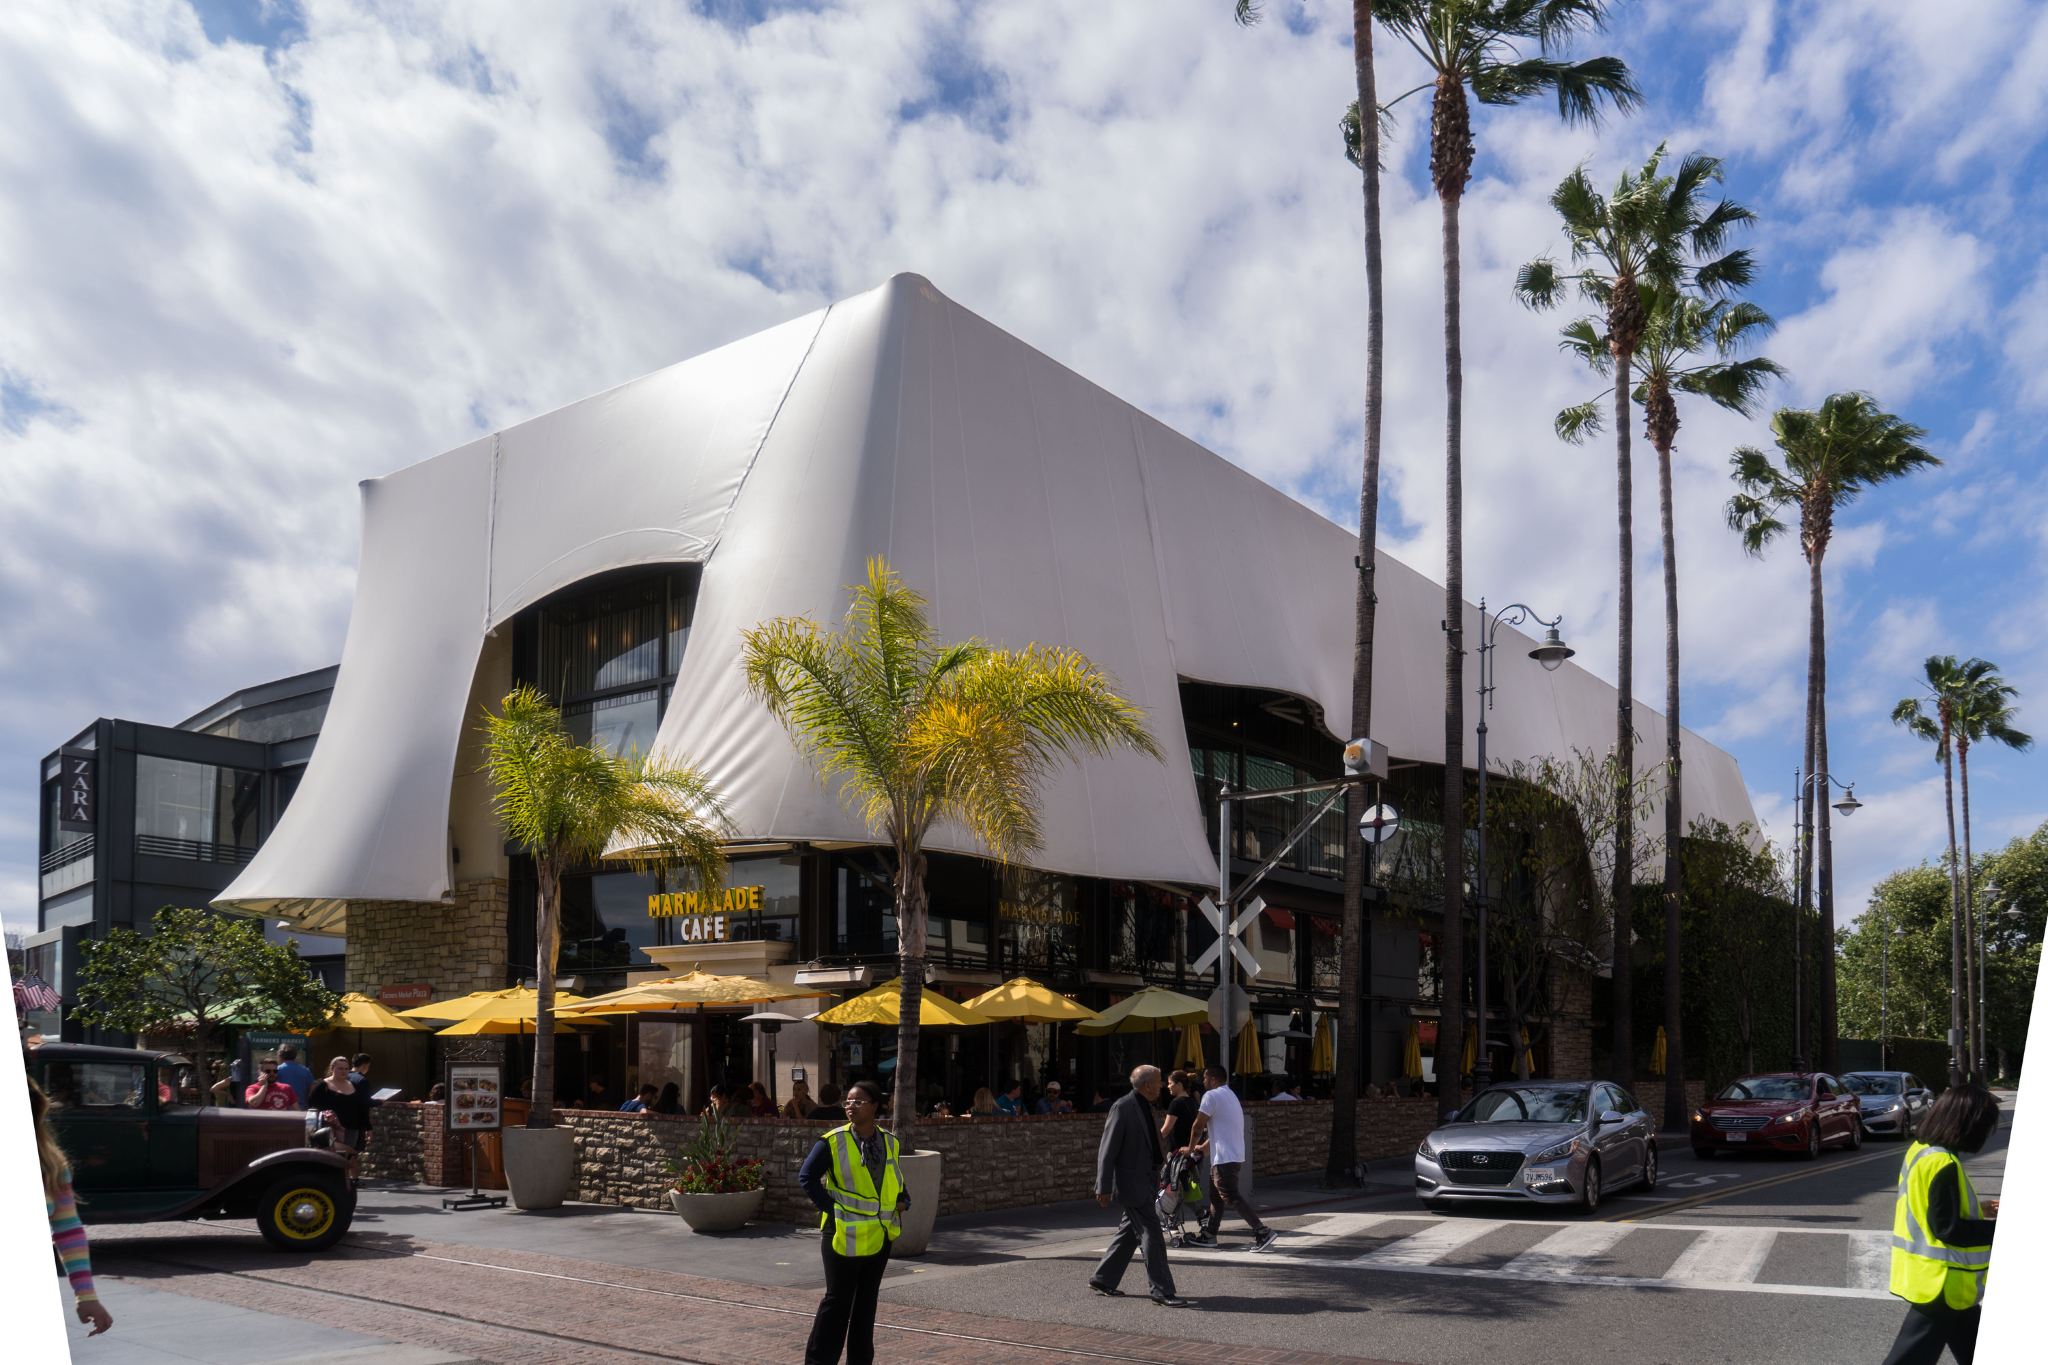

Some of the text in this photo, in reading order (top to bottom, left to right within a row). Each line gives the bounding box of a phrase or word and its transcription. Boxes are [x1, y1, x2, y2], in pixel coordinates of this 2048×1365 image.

[71, 759, 90, 821] ZARA
[647, 885, 764, 917] MARMALADE
[680, 915, 727, 941] CAFE
[853, 1046, 860, 1056] A
